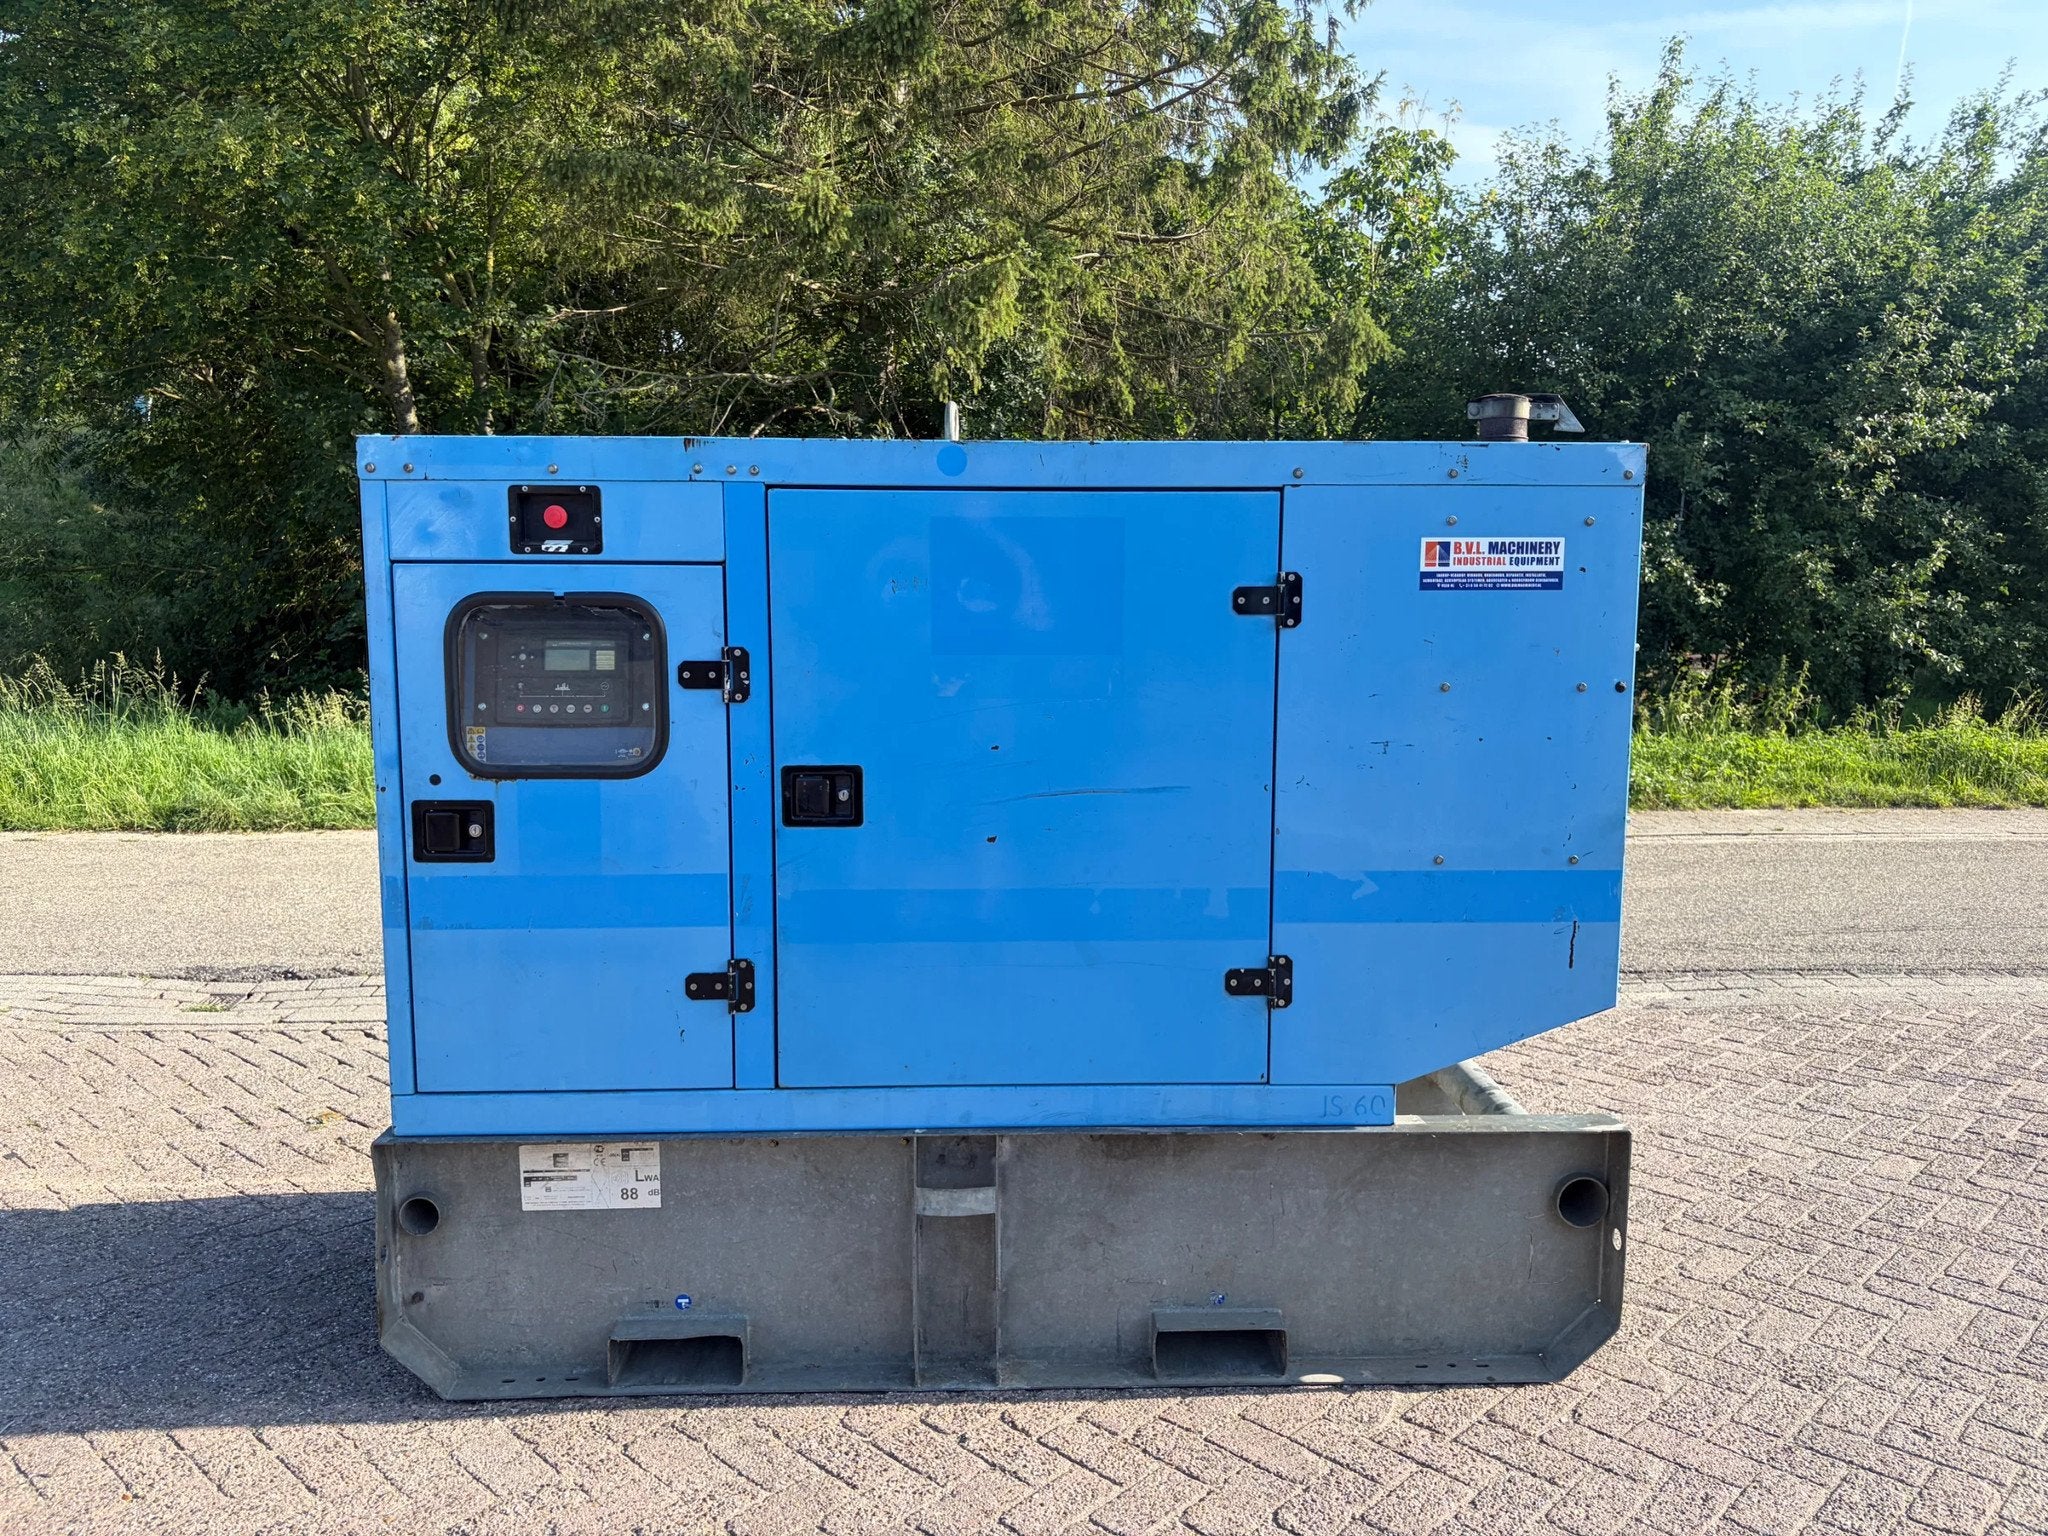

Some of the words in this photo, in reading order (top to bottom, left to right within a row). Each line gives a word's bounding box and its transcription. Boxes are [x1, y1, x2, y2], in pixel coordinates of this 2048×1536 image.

[1454, 541, 1486, 555] B.V.L.
[1488, 541, 1560, 554] MACHINERY
[1452, 557, 1506, 566] INDUSTRIAL
[1509, 557, 1560, 567] EQUIPMENT
[621, 1188, 638, 1201] 88
[648, 1188, 660, 1197] dB
